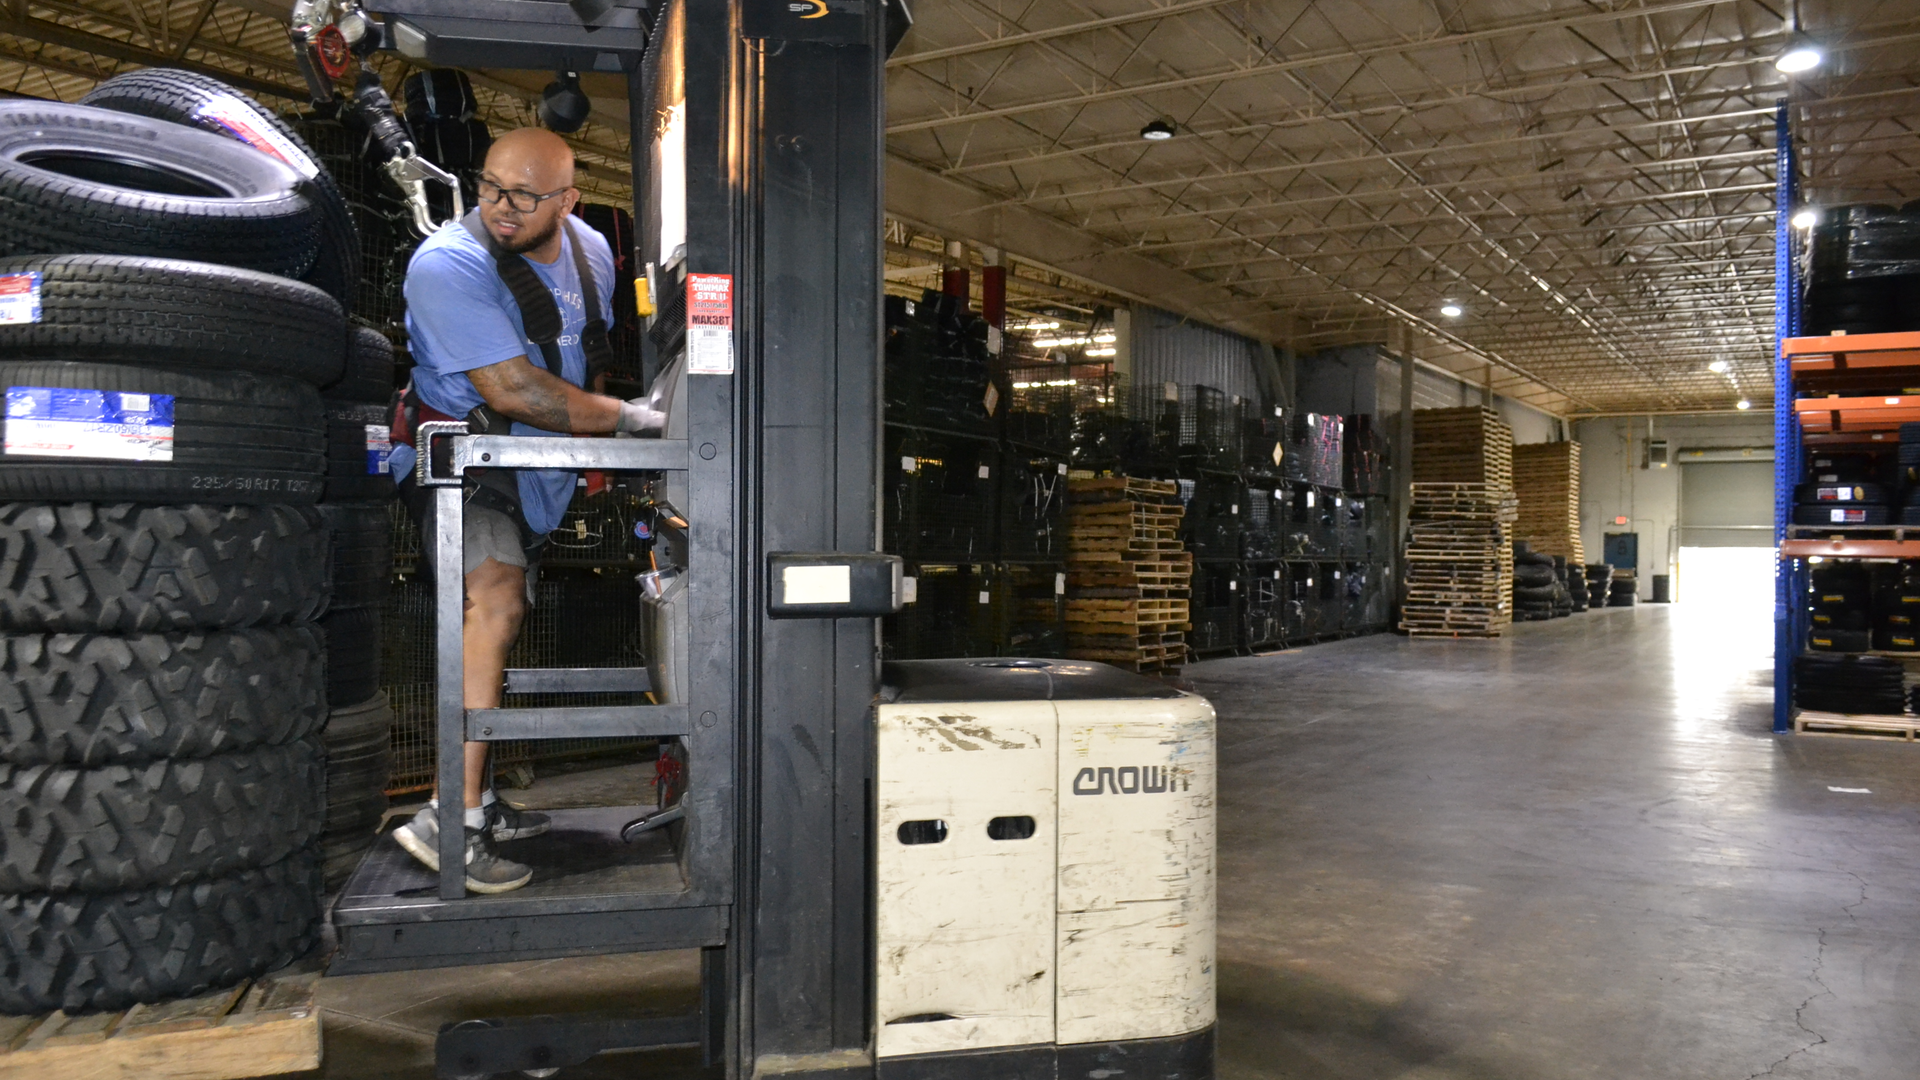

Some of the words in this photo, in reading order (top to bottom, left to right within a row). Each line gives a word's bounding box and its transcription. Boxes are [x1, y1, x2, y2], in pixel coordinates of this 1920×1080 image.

[789, 3, 813, 12] SP
[692, 284, 730, 292] TOWMAX
[697, 292, 717, 300] STR
[1072, 765, 1189, 796] CROWN
